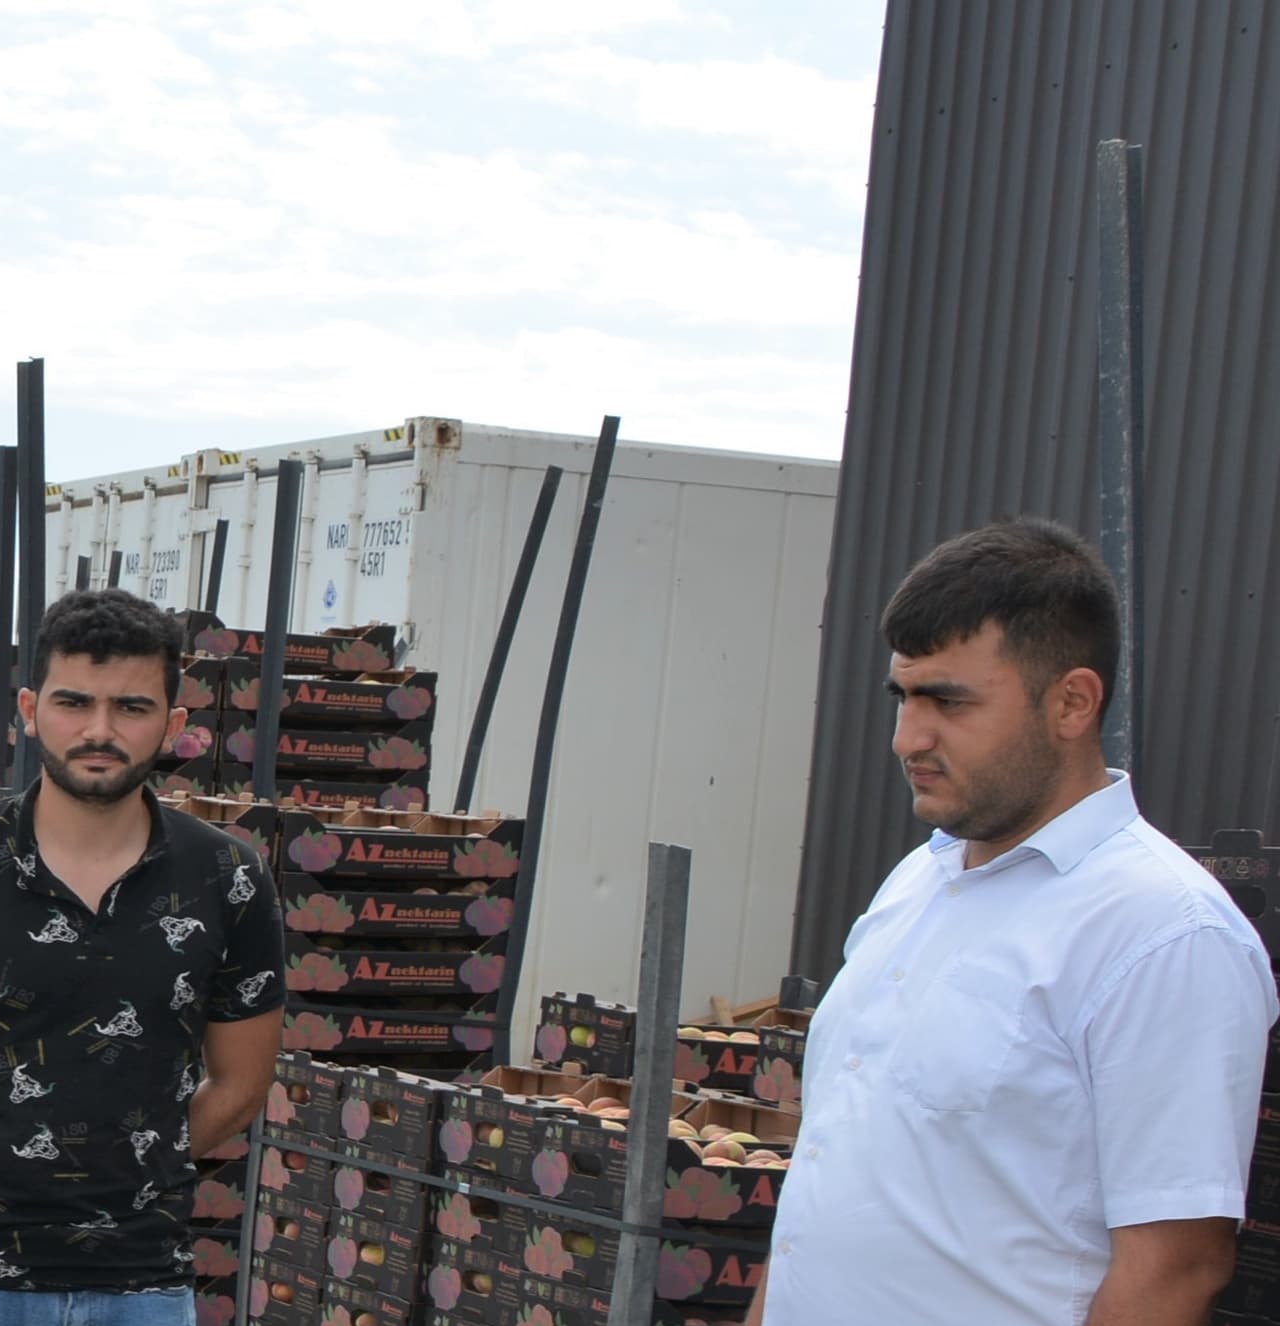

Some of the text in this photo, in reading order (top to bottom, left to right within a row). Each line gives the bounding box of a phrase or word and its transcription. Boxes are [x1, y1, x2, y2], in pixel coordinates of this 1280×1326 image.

[363, 520, 402, 547] 777652
[360, 552, 386, 577] 45R1
[61, 1122, 88, 1135] 180
